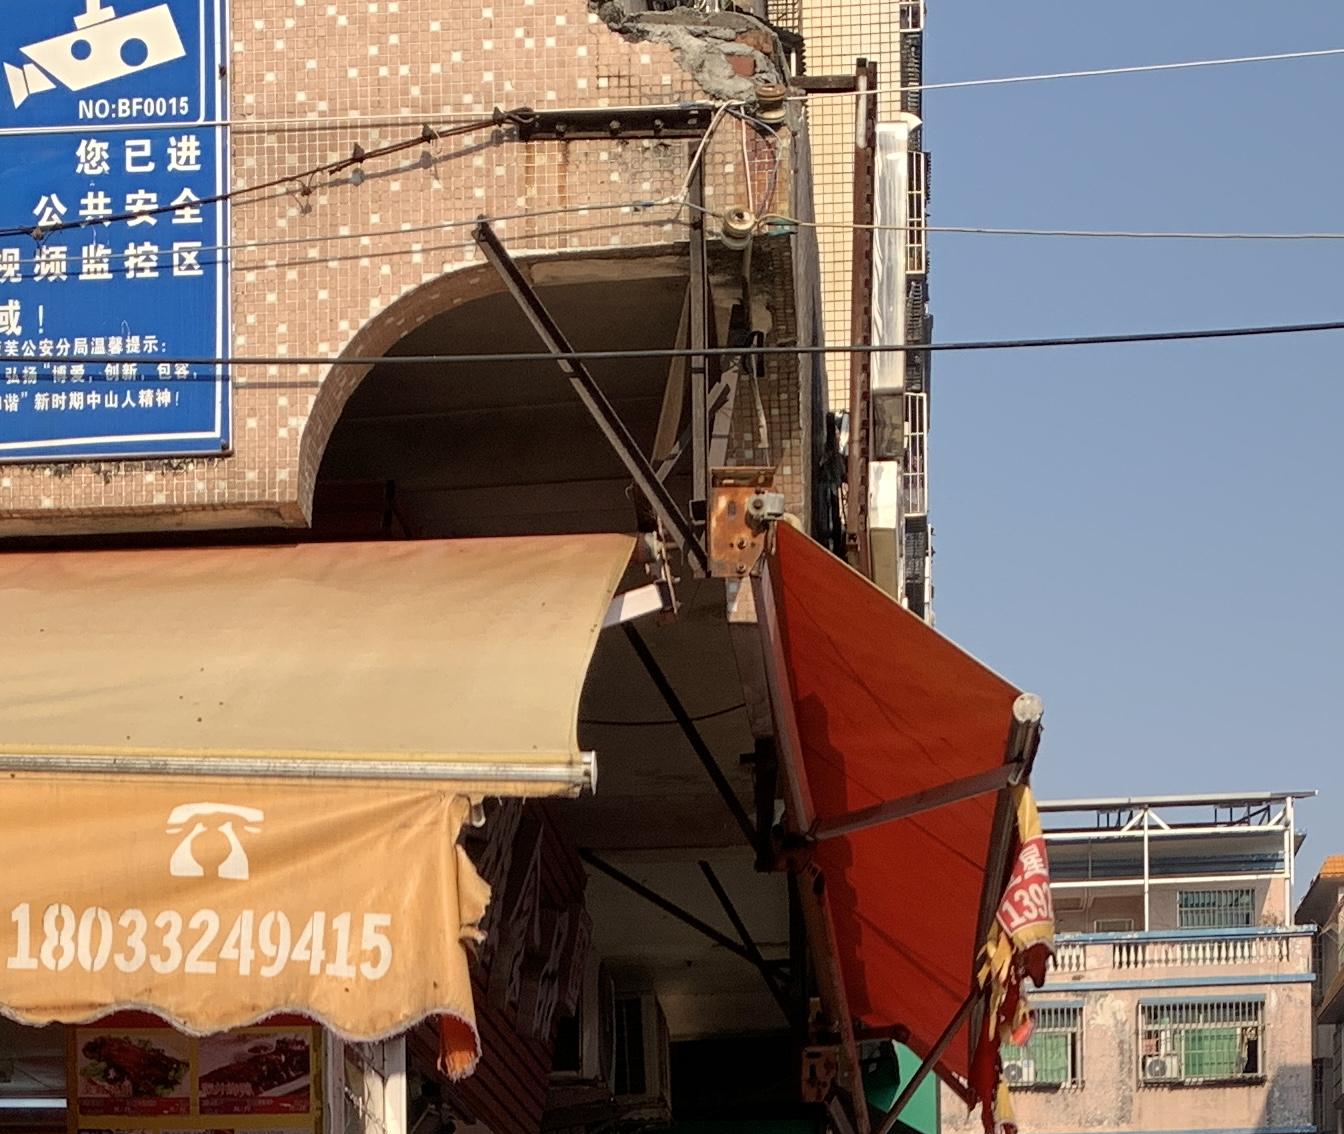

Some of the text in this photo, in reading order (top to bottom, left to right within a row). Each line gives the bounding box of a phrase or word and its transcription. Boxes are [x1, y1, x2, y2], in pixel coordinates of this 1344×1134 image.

[78, 96, 190, 120] NO:BF0015
[75, 135, 203, 175] 您已进
[32, 187, 205, 229] 公共安全
[6, 902, 394, 982] 18033249415
